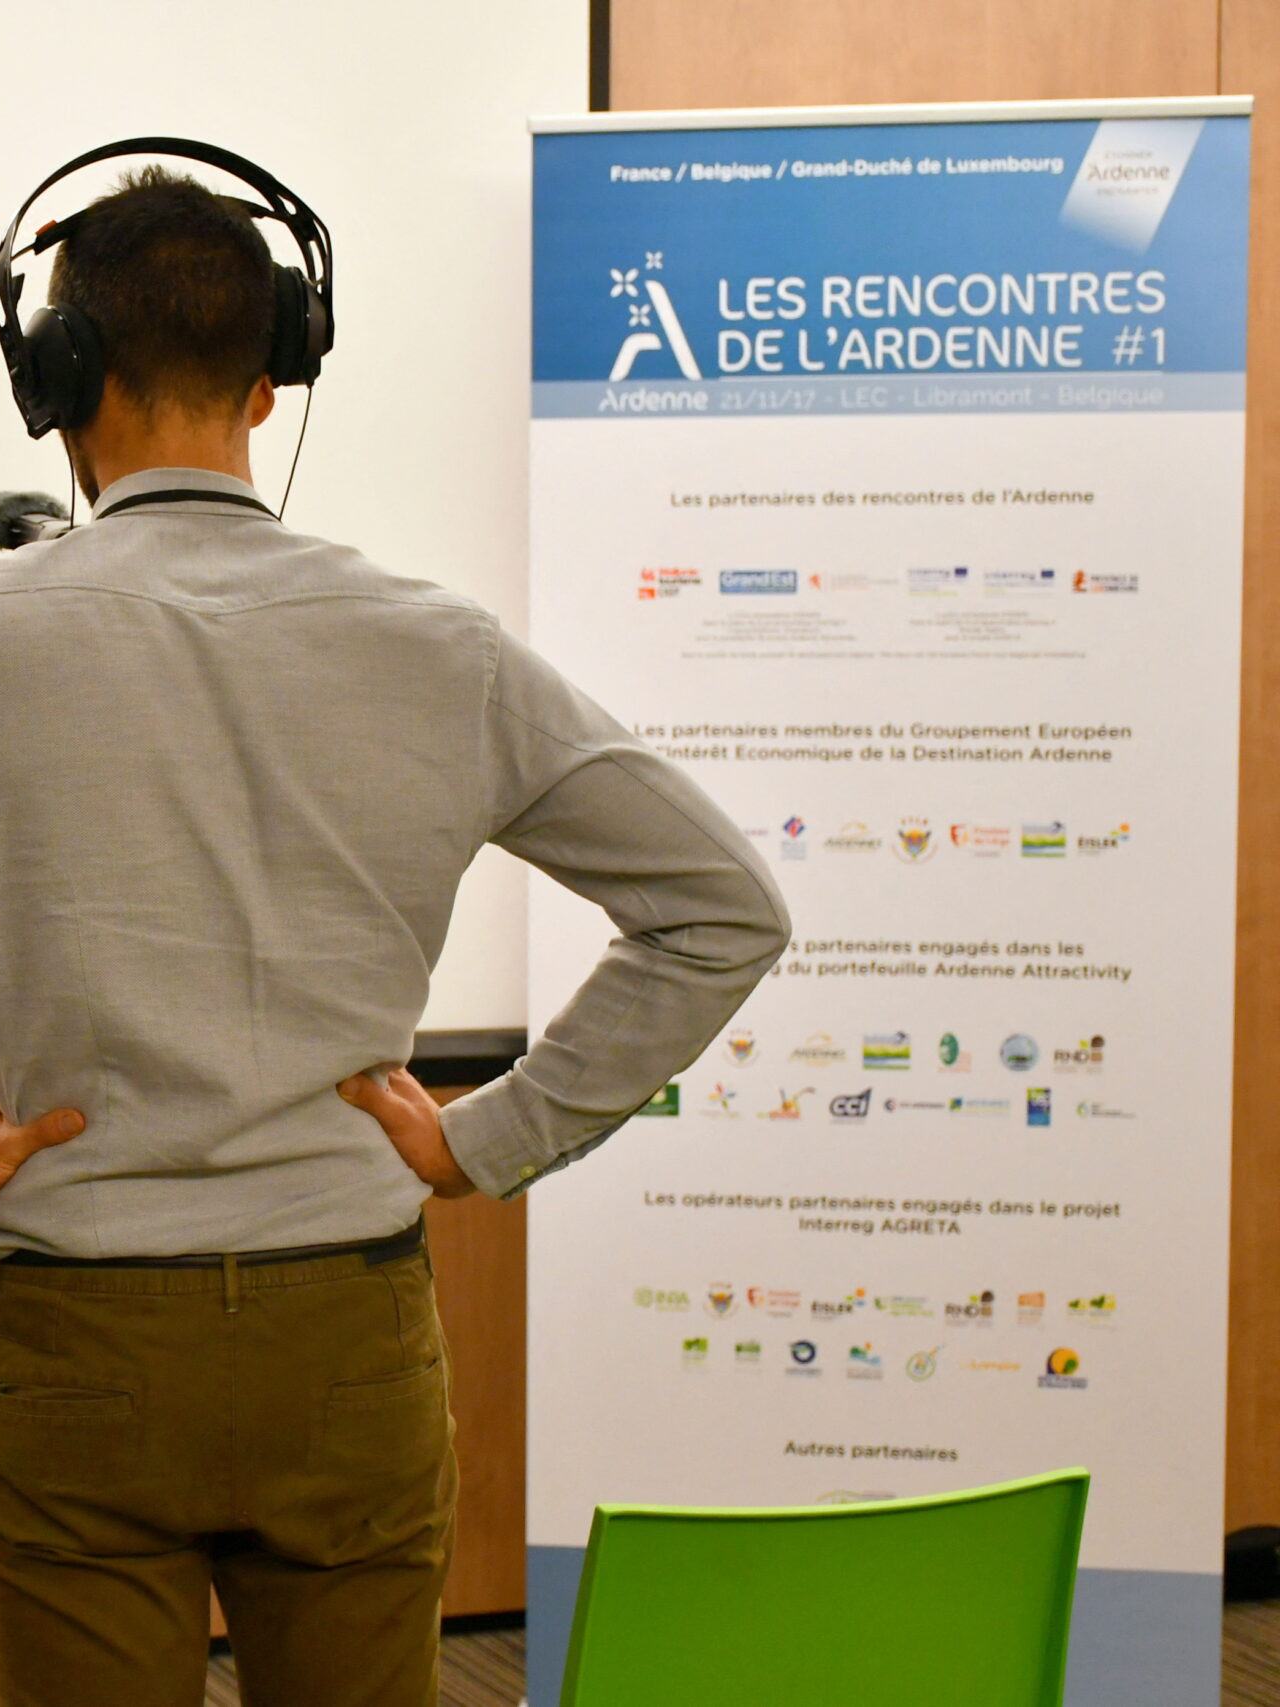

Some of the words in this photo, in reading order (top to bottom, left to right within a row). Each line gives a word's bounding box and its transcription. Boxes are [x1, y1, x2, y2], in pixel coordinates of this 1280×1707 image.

[610, 165, 672, 182] France
[675, 162, 688, 183] /
[691, 162, 772, 182] Belgique
[776, 159, 788, 180] /
[791, 157, 911, 178] Grand-Duché
[917, 157, 941, 174] de
[946, 155, 1064, 175] Luxembourg
[1087, 163, 1170, 181] Ardenne
[719, 277, 807, 321] LES
[822, 271, 1166, 319] RENCONTRES
[719, 328, 783, 372] DE
[798, 323, 1083, 371] L'ARDENNE
[1111, 326, 1166, 367] #1
[598, 387, 709, 412] Ardenne
[721, 388, 816, 411] 21/11/17
[839, 386, 888, 409] LEC
[913, 385, 1033, 408] Libramont
[1057, 383, 1164, 410] Belgique
[671, 491, 704, 508] Les
[708, 490, 816, 512] partenaires
[822, 490, 856, 507] des
[862, 493, 966, 507] rencontres
[971, 489, 996, 505] de
[1002, 488, 1095, 505] l'Ardenne
[634, 723, 666, 739] Les
[672, 722, 778, 742] partenaires
[785, 722, 874, 738] membres
[880, 722, 904, 738] du
[910, 722, 1032, 742] Groupement
[1038, 722, 1132, 742] Européen
[735, 745, 853, 764] Economique
[860, 745, 884, 761] de
[890, 745, 907, 761] la
[913, 745, 1024, 762] Destination
[1030, 746, 1113, 762] Ardenne
[804, 938, 912, 957] partenaires
[919, 938, 1000, 959] engagés
[1006, 938, 1050, 956] dans
[1056, 939, 1085, 956] les
[787, 960, 812, 976] du
[819, 960, 929, 980] portefeuille
[935, 961, 1016, 978] Ardenne
[1022, 963, 1132, 984] Attractivity
[644, 1191, 675, 1207] Les
[681, 1191, 783, 1211] opérateurs
[789, 1195, 896, 1215] partenaires
[902, 1196, 983, 1218] engagés
[989, 1199, 1034, 1216] dans
[1040, 1200, 1057, 1217] le
[1063, 1200, 1120, 1221] projet
[799, 1217, 875, 1237] Interreg
[880, 1218, 961, 1235] AGRETA
[784, 1439, 846, 1457] Autres
[852, 1442, 959, 1463] partenaires
